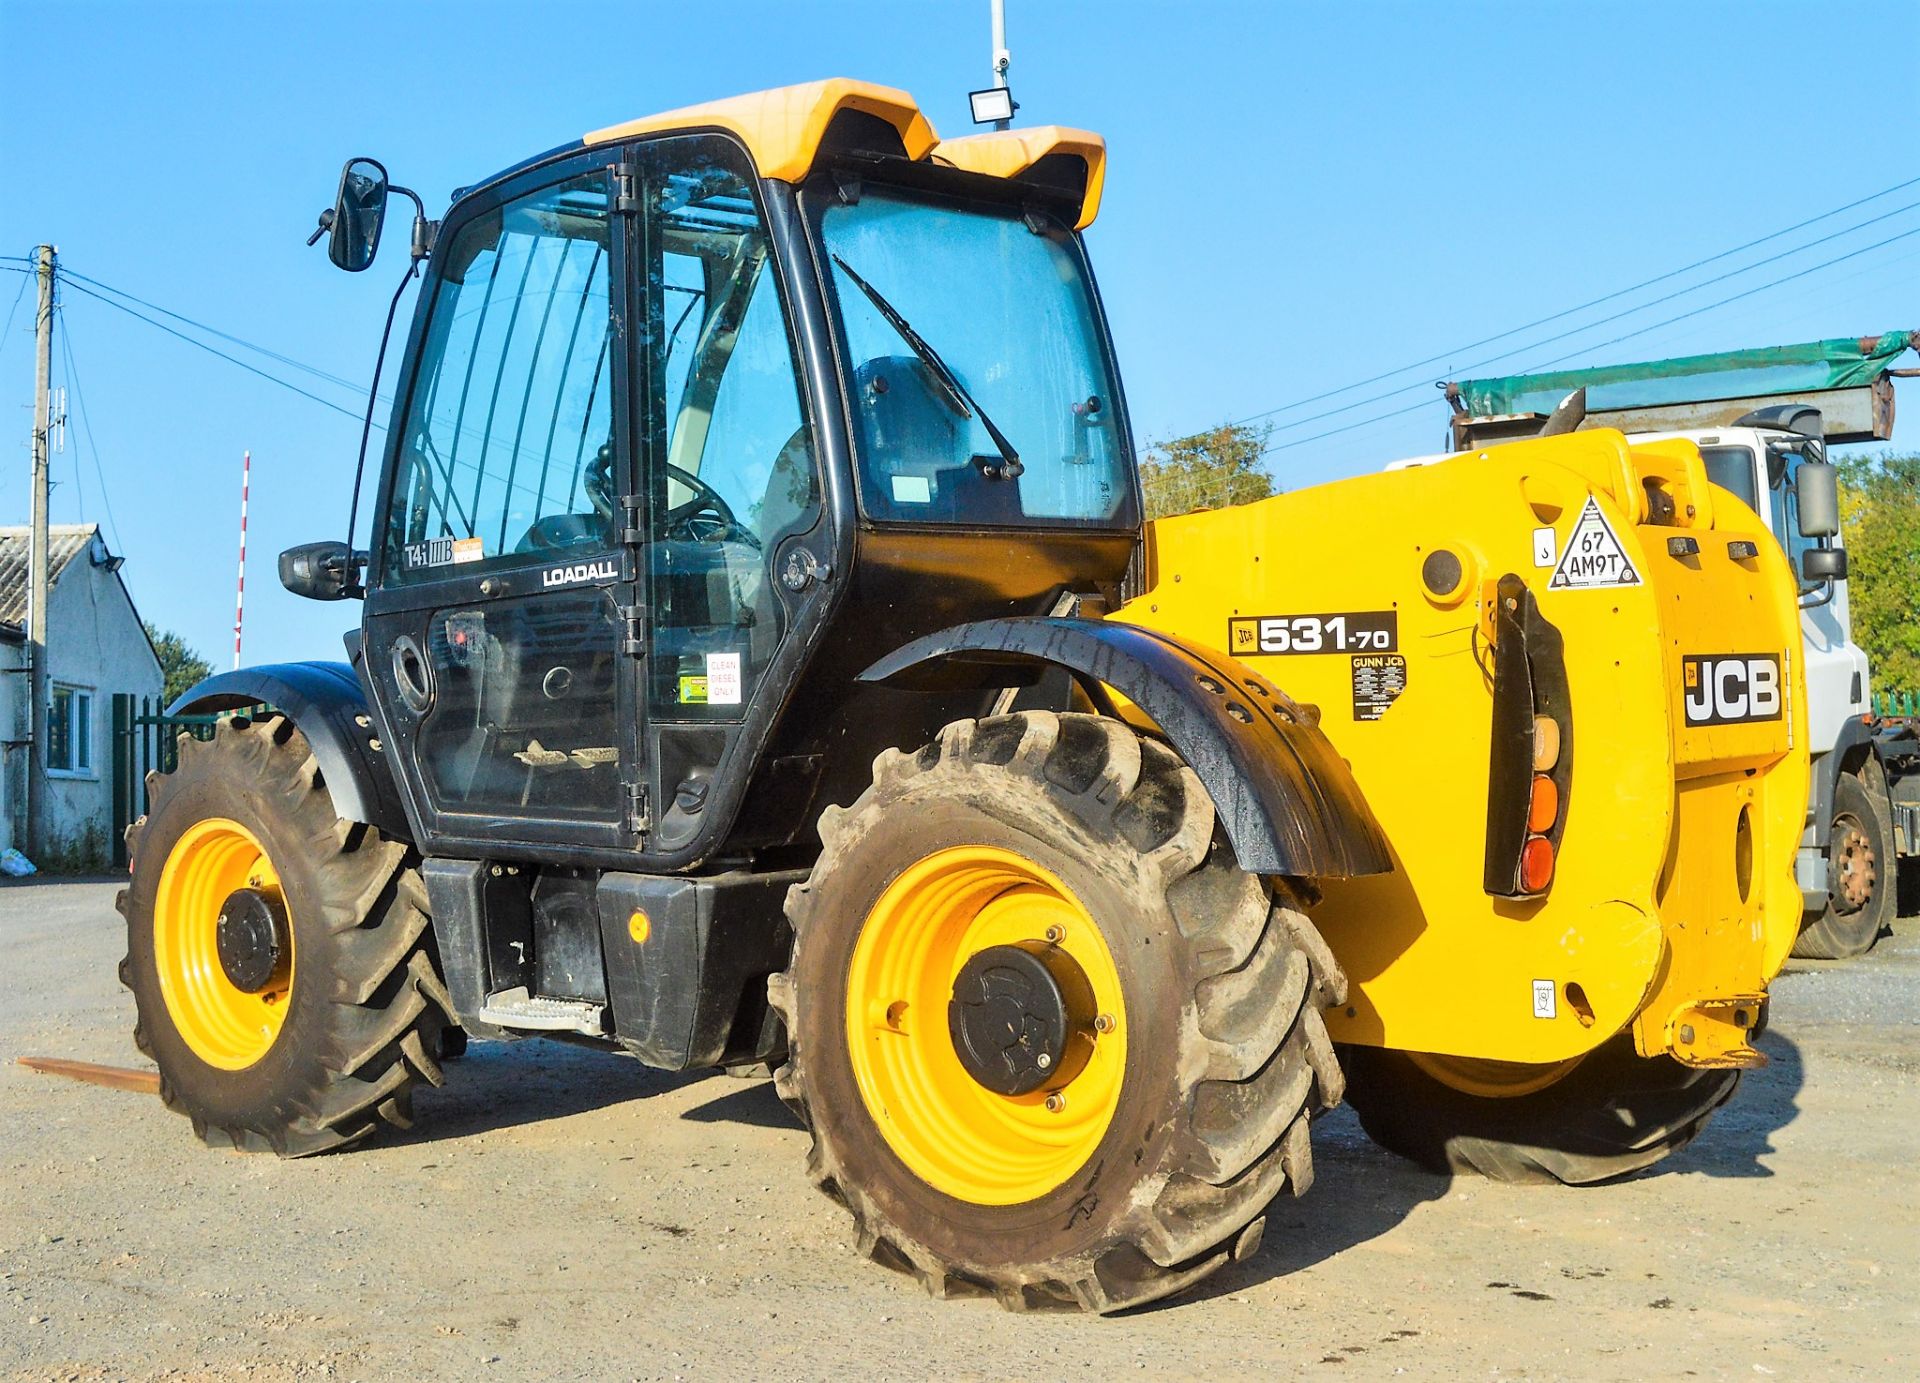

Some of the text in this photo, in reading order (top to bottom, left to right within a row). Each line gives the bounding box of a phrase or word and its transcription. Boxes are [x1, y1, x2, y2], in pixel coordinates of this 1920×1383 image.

[1581, 531, 1605, 553] 67
[404, 543, 428, 568] T4i
[1569, 553, 1619, 577] AM9T
[542, 561, 619, 587] LOADALL
[1259, 616, 1390, 652] 531-70
[710, 661, 737, 671] CLEAN
[1352, 655, 1405, 668] GUNN JCB
[710, 673, 737, 684] DIESEL
[1685, 659, 1780, 721] JCB
